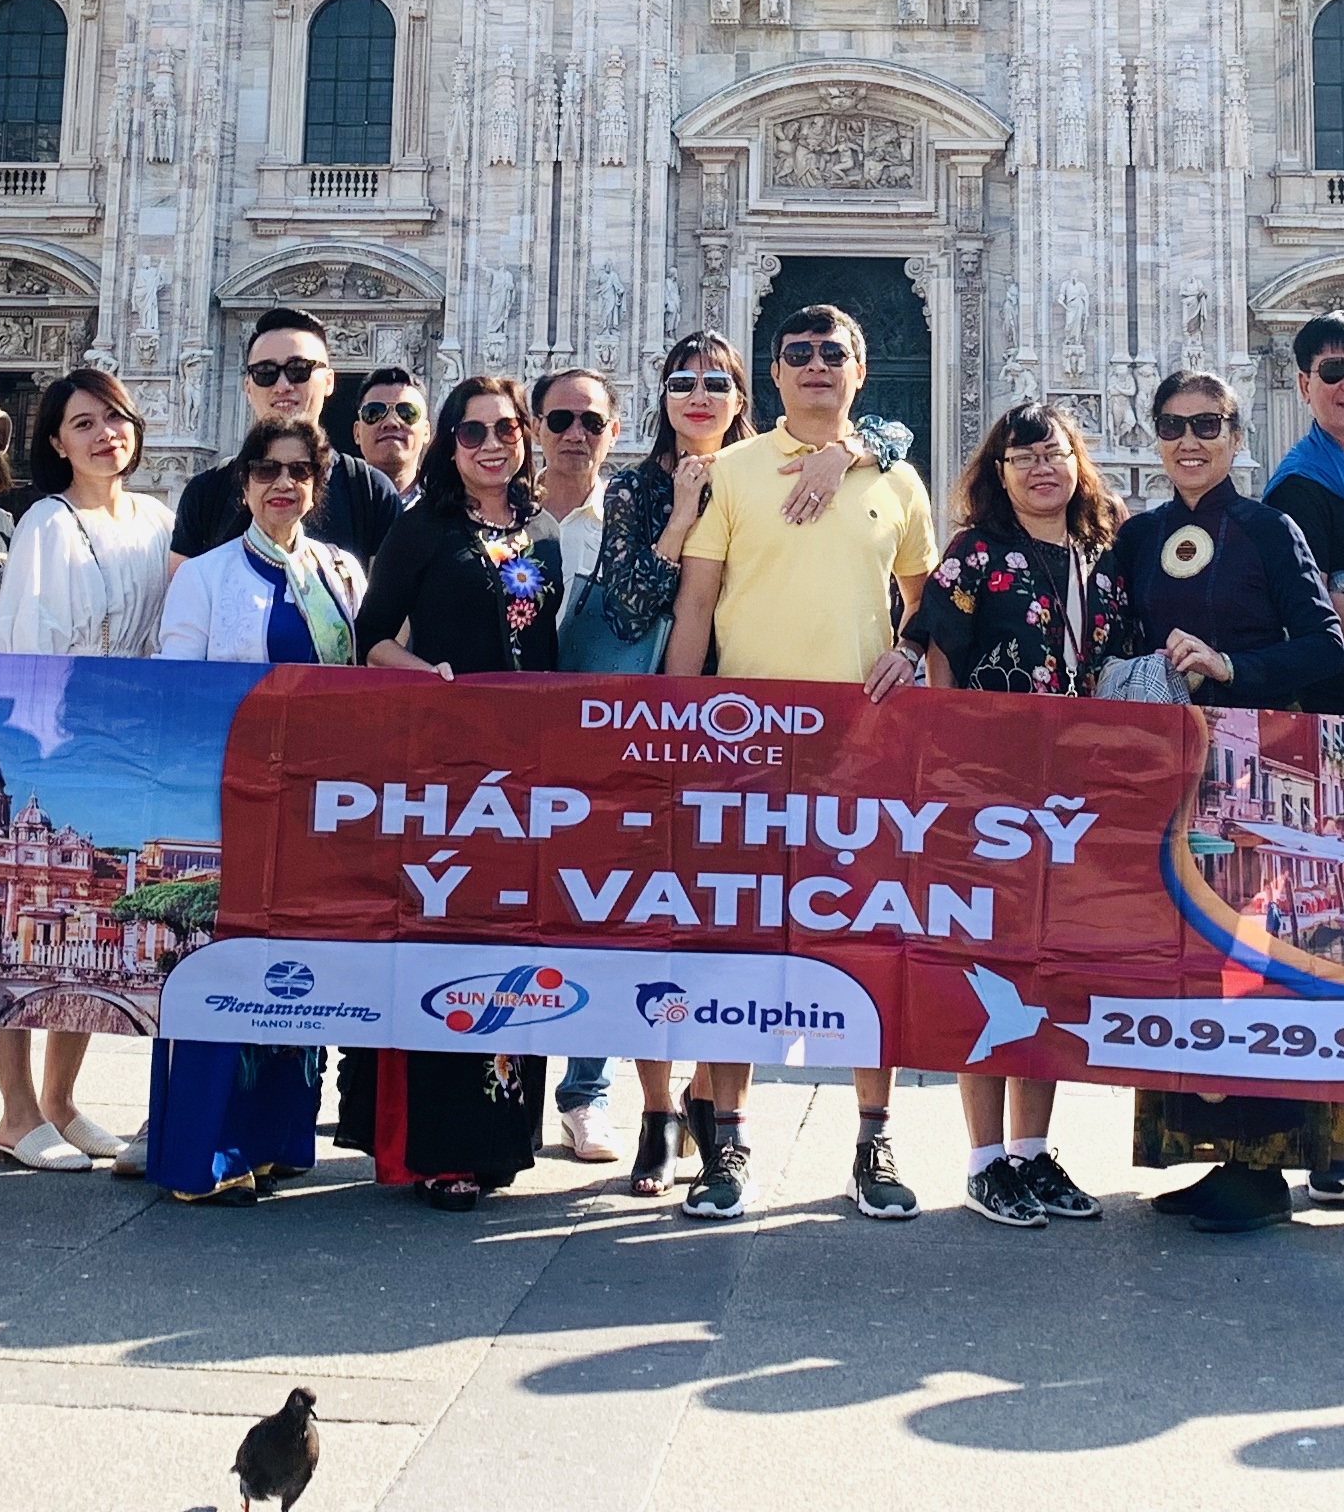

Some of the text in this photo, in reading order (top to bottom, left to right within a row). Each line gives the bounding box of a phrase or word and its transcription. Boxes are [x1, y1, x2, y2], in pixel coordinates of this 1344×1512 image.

[580, 692, 825, 743] DIAMOND
[621, 742, 784, 766] ALLIANCE
[313, 770, 1100, 865] PHÁP - THỤY SỸ
[402, 849, 994, 941] Ý - VATICAN
[205, 994, 382, 1023] Vietnamtourism
[445, 991, 566, 1009] SUN TRAVEL
[693, 998, 846, 1033] dolphin
[251, 1019, 326, 1030] HANOI JSC.
